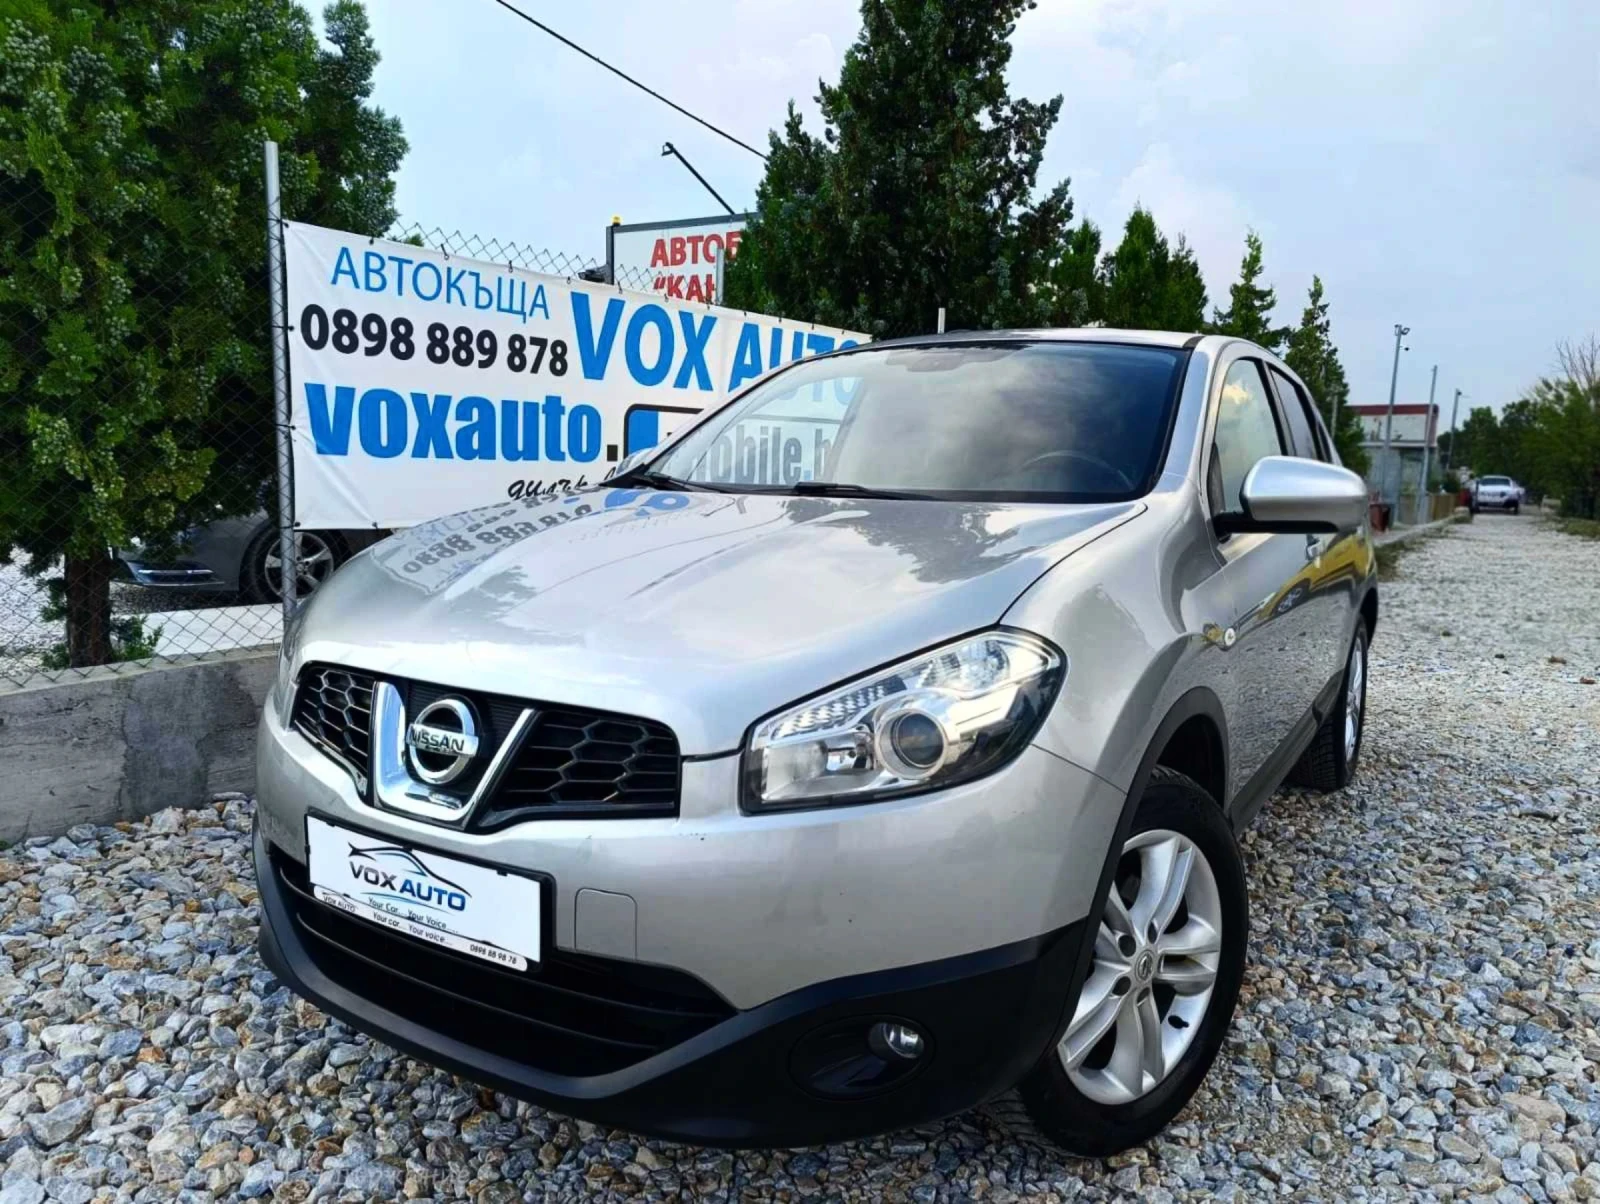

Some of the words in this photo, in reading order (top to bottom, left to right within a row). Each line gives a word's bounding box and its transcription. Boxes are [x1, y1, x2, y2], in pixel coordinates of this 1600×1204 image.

[331, 247, 549, 323] АВТОКЪЩА
[301, 304, 415, 360] 0898
[426, 322, 498, 369] 889
[507, 334, 568, 376] 878
[570, 291, 718, 392] VOX
[409, 725, 465, 751] NISSAN
[349, 861, 396, 891] VOX
[399, 879, 466, 912] AUTO
[368, 896, 384, 910] Your
[407, 908, 424, 921] Your
[373, 911, 387, 923] Your
[409, 924, 424, 937] Your
